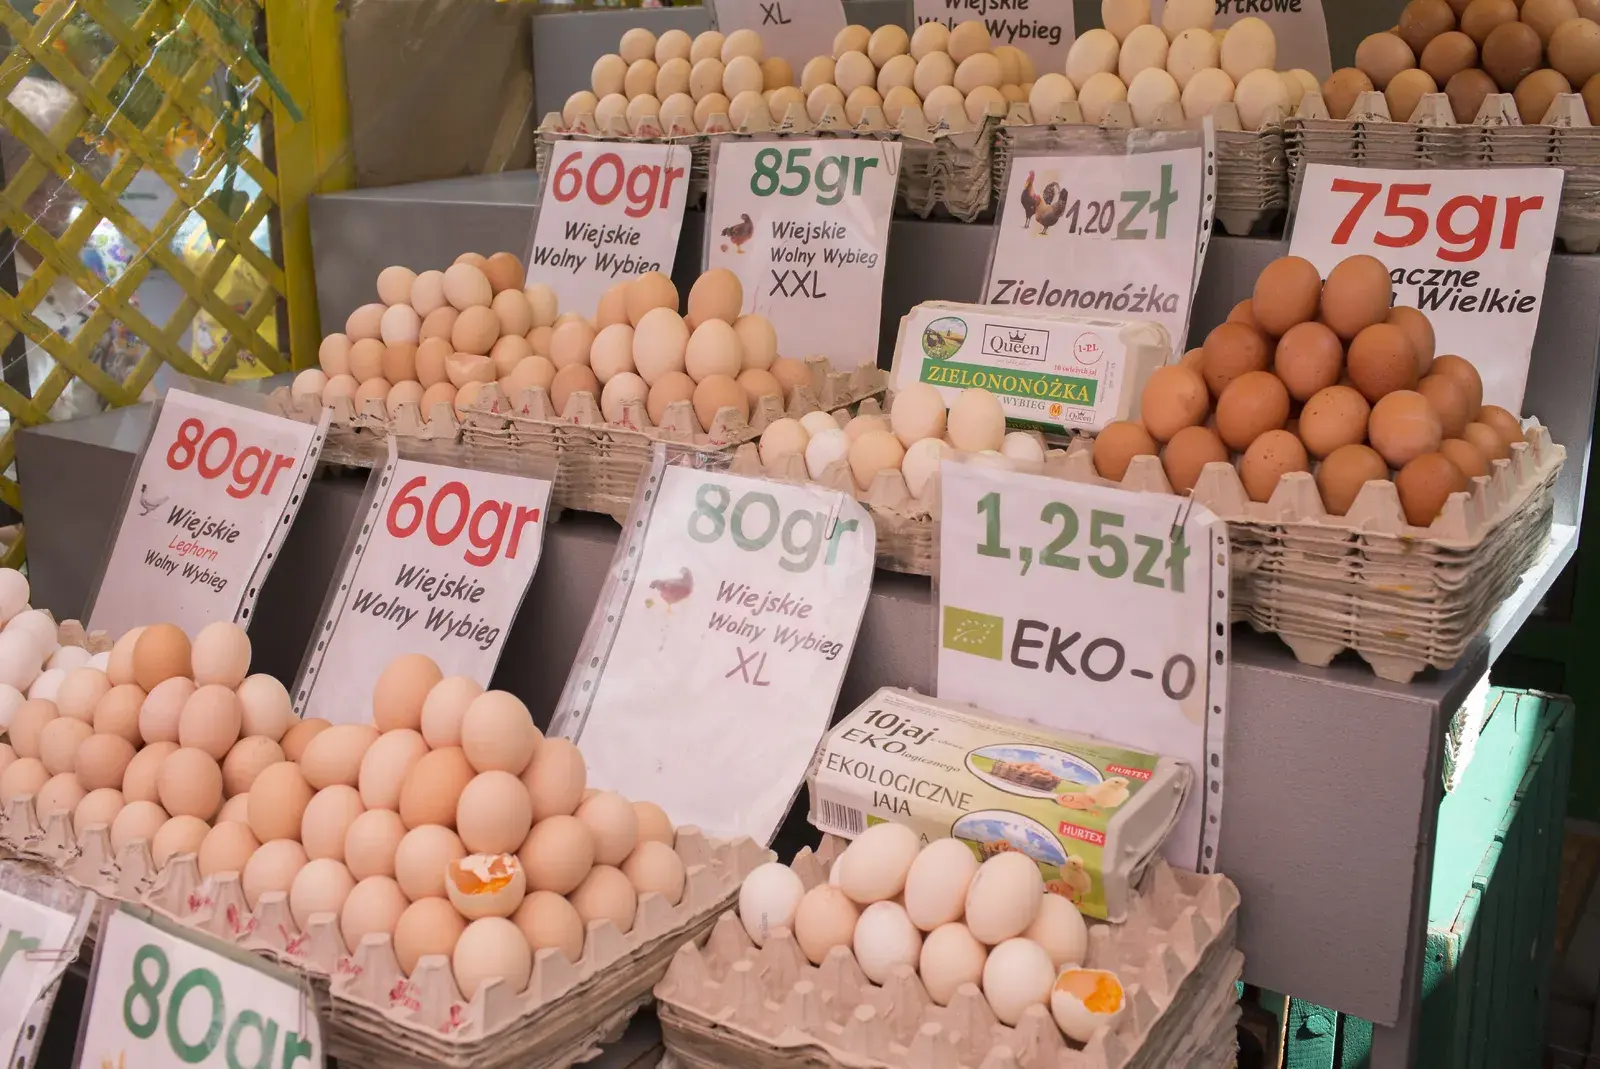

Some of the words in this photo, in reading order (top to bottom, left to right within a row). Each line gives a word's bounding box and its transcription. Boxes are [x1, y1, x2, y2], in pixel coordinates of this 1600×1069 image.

[759, 3, 792, 25] XL
[985, 18, 1062, 46] Wybieg
[552, 151, 685, 218] 60gr
[750, 147, 879, 206] 85gr
[564, 220, 641, 248] Wiejskie
[771, 220, 847, 244] Wiejskie
[1330, 178, 1544, 263] 75gr
[533, 246, 587, 274] Wolny
[769, 247, 817, 268] Wolny
[823, 247, 878, 269] Wybieg
[768, 268, 827, 299] XXL
[990, 279, 1180, 314] Zielononóżka
[1389, 267, 1481, 288] aczne
[1417, 285, 1537, 314] Wielkie
[989, 335, 1040, 356] Queen
[926, 365, 1091, 403] ZIELONONÓŻKA
[1002, 396, 1047, 411] WYBIEG
[166, 417, 296, 500] 80gr
[166, 504, 241, 544] Wiejskie
[386, 475, 540, 567] 60gr
[687, 482, 859, 573] 80gr
[168, 533, 219, 561] Leghorn
[976, 491, 1191, 594] 1,25zł
[144, 549, 180, 577] Wolny
[181, 561, 228, 593] Wybieg
[394, 563, 486, 604] Wiejskie
[715, 580, 814, 620] Wiejskie
[351, 588, 419, 631] Wolny
[424, 606, 501, 651] Wybieg
[707, 611, 766, 644] Wolny
[773, 624, 844, 661] Wybieg
[724, 646, 771, 687] XL
[825, 751, 974, 812] EKOLOGICZNE
[1109, 765, 1151, 780] HURTEX
[1062, 824, 1104, 844] HURTEX
